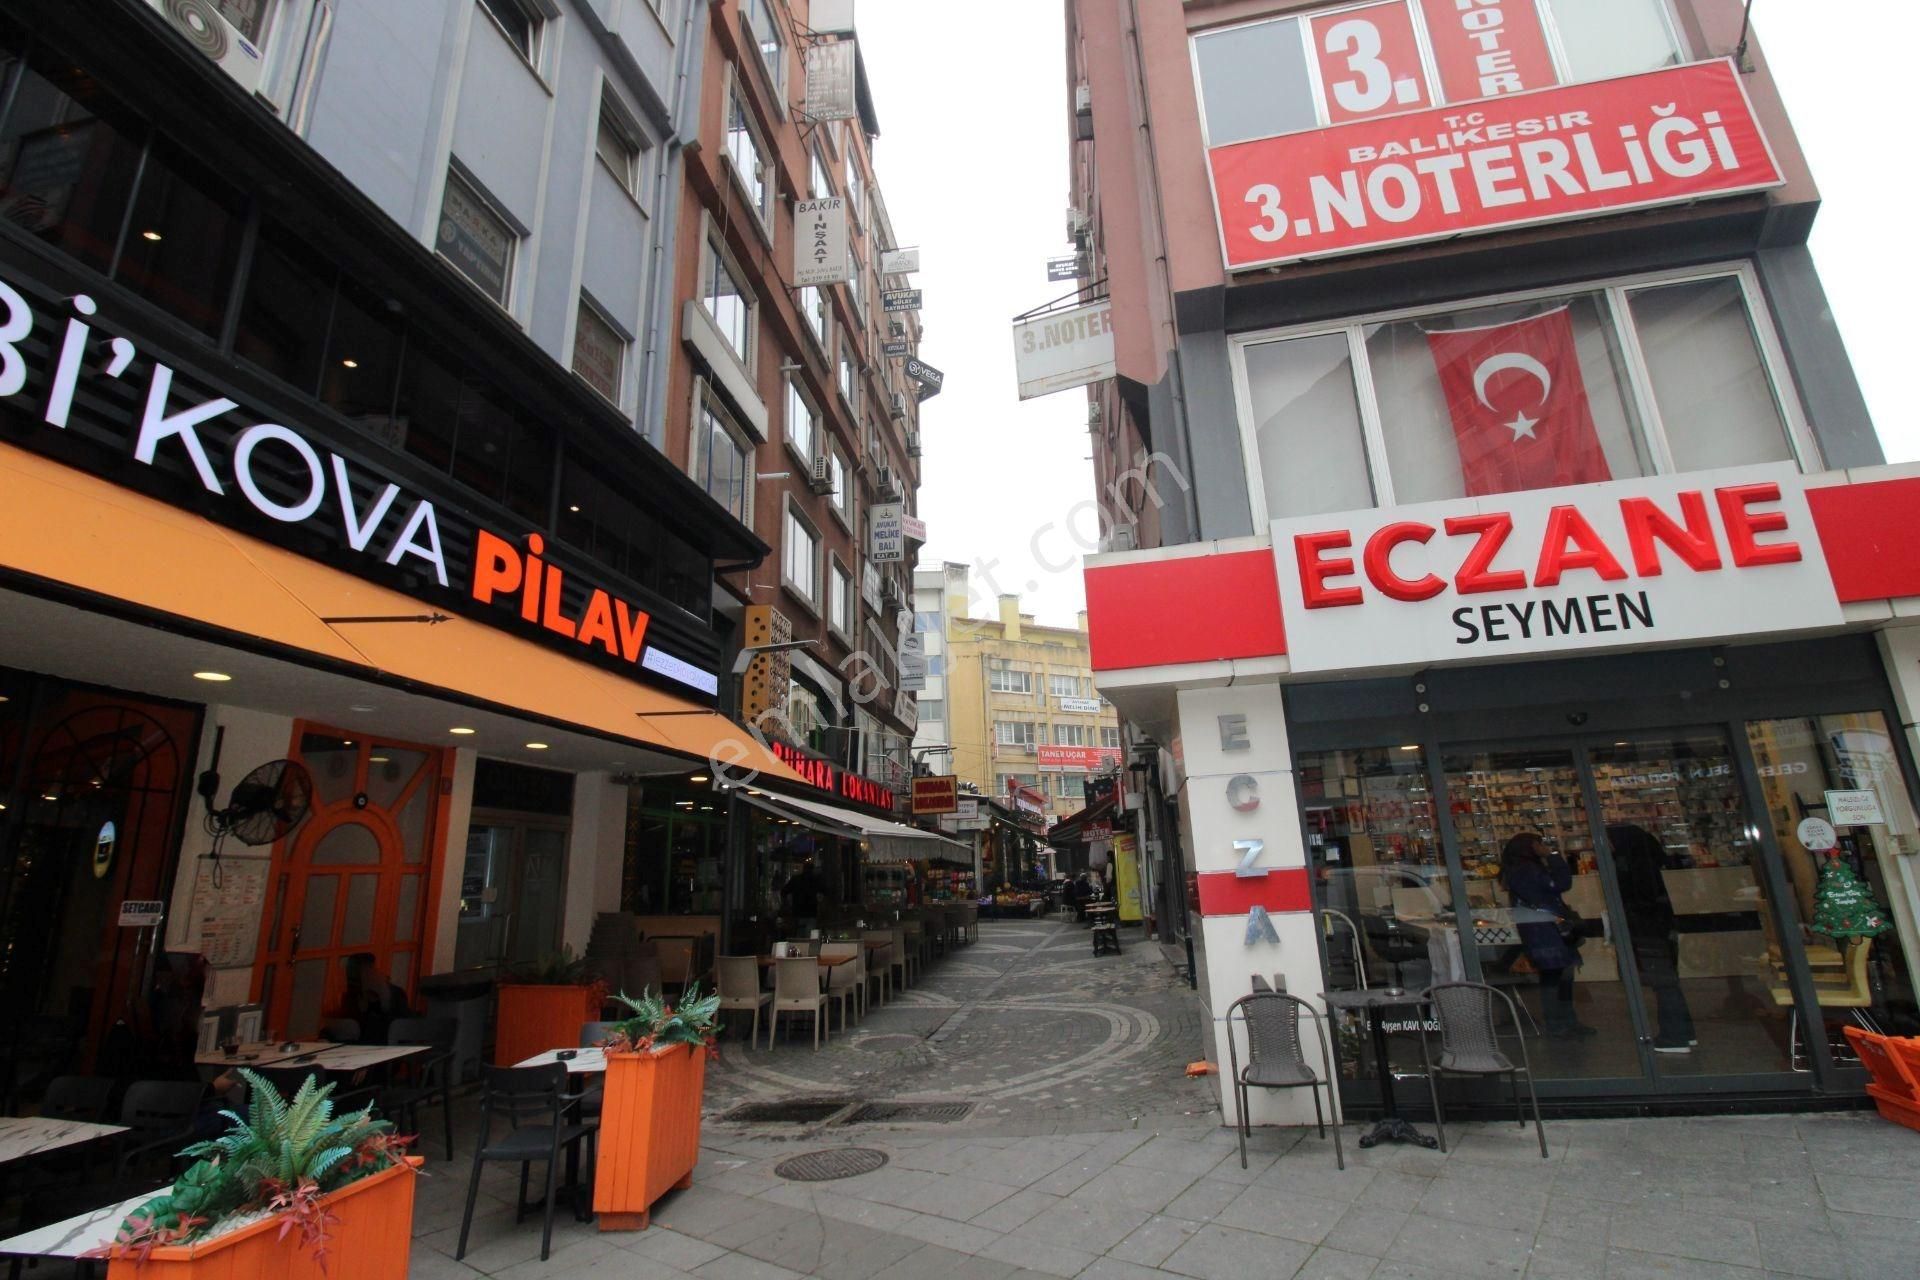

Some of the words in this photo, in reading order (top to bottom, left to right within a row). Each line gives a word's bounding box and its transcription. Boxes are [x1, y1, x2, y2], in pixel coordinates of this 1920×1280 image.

[1325, 19, 1419, 113] 3.
[1444, 111, 1486, 129] T.C
[1349, 110, 1592, 164] BALIKESİR
[1244, 103, 1739, 243] 3.NOTERLİĞİ
[799, 199, 841, 213] BAKIR
[886, 290, 919, 301] AVUKAT
[921, 366, 941, 384] VEGA
[876, 520, 897, 528] AVUKAT
[874, 530, 900, 540] MELİKE
[1294, 481, 1803, 610] ECZANE
[473, 529, 650, 663] PİLAV
[1452, 591, 1655, 645] SEYMEN
[1041, 750, 1064, 758] TANER
[1065, 750, 1086, 759] UÇAR
[122, 902, 162, 914] SETCARD
